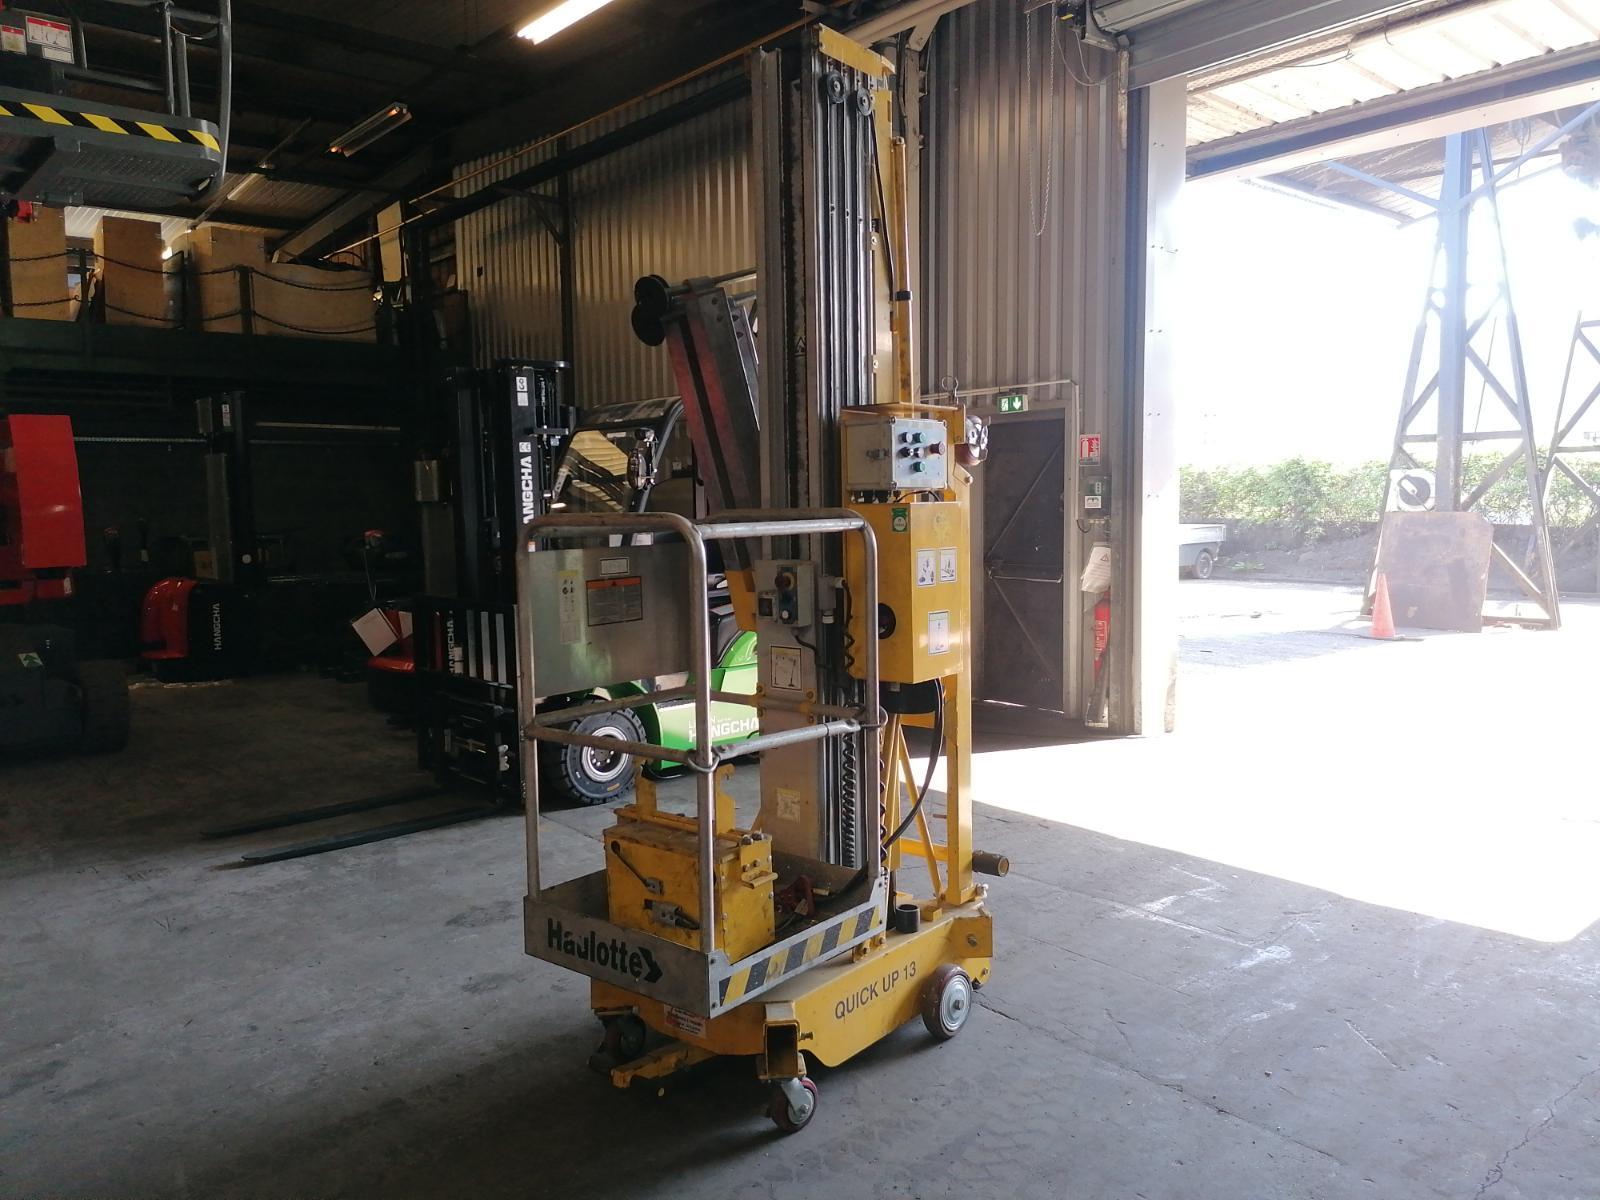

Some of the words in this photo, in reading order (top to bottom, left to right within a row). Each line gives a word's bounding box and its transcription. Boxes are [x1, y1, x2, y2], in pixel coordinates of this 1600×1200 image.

[520, 456, 534, 524] ANGCHA
[212, 603, 222, 650] HANGCHA
[688, 716, 759, 743] HNGCHA
[547, 918, 643, 978] Haulotte
[835, 980, 878, 1019] QUICK
[882, 970, 900, 993] UP
[903, 961, 917, 981] 13
